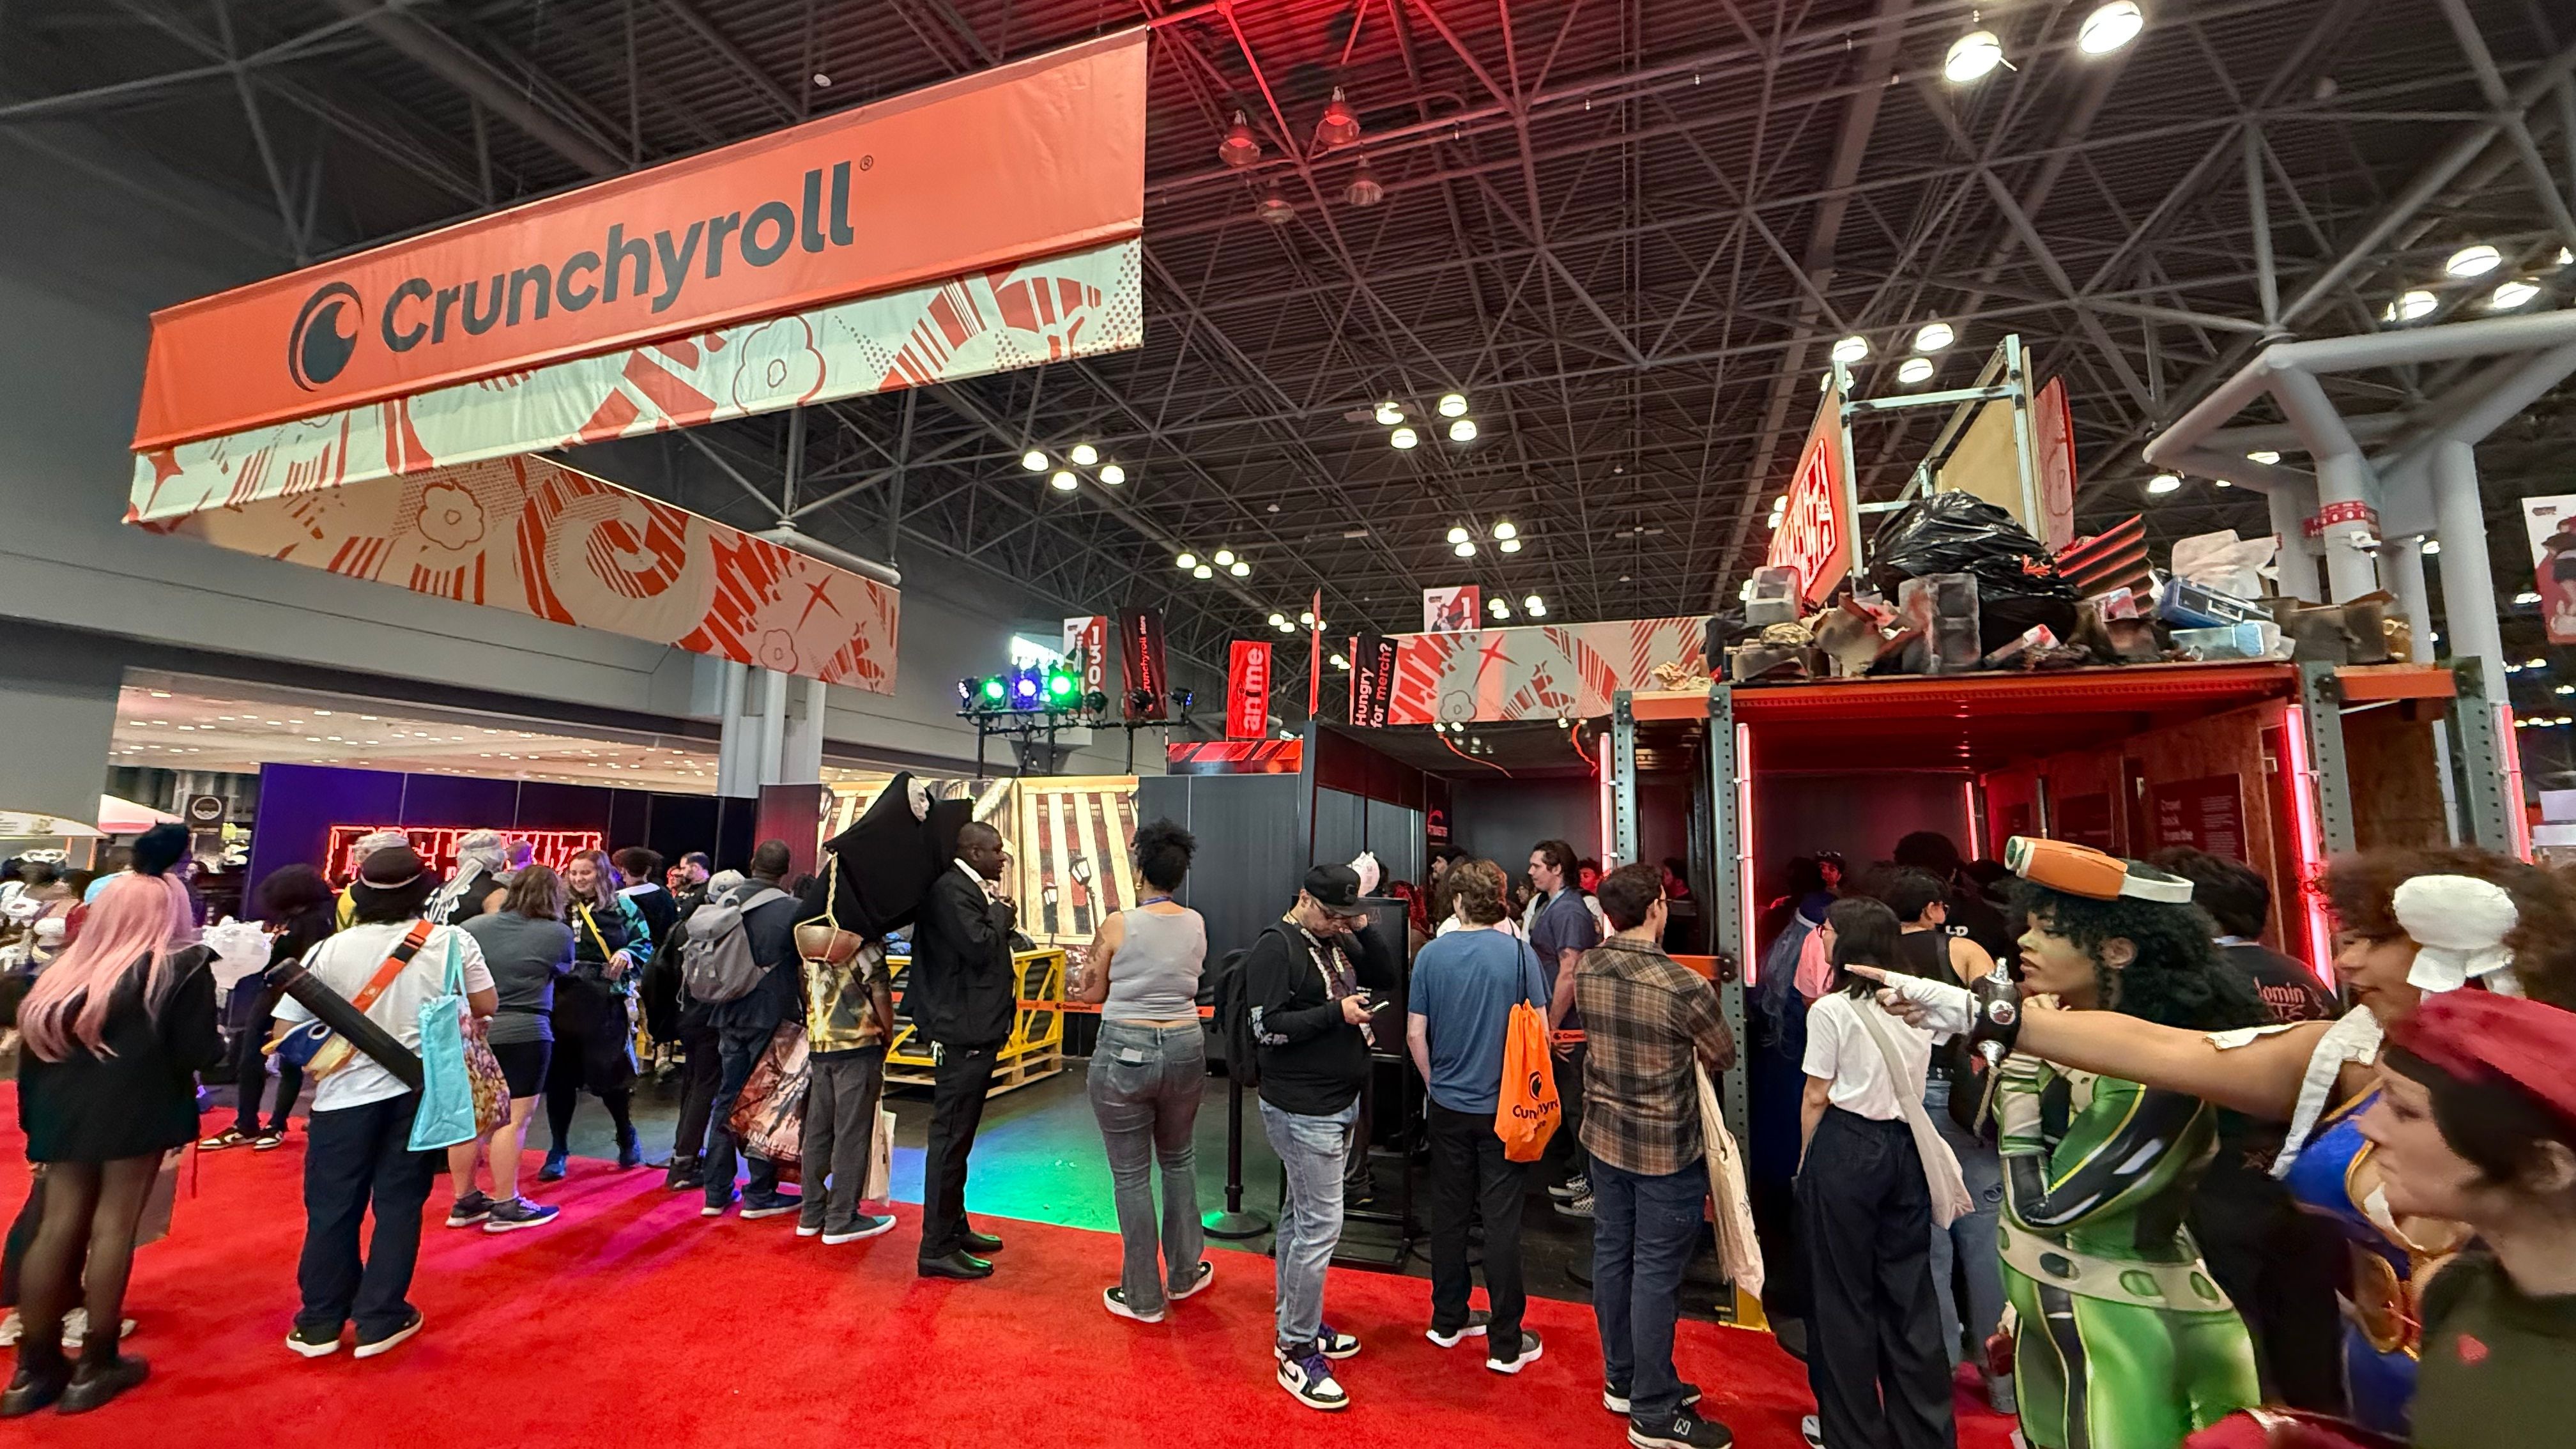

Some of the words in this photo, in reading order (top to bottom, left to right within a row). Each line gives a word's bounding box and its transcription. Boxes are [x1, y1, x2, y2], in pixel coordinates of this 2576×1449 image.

[381, 160, 855, 353] Crunchyroll
[1087, 625, 1102, 693] 130
[1243, 647, 1264, 732] anime
[1376, 642, 1392, 701] merch?
[1354, 666, 1374, 726] Hungry
[1370, 704, 1384, 728] for
